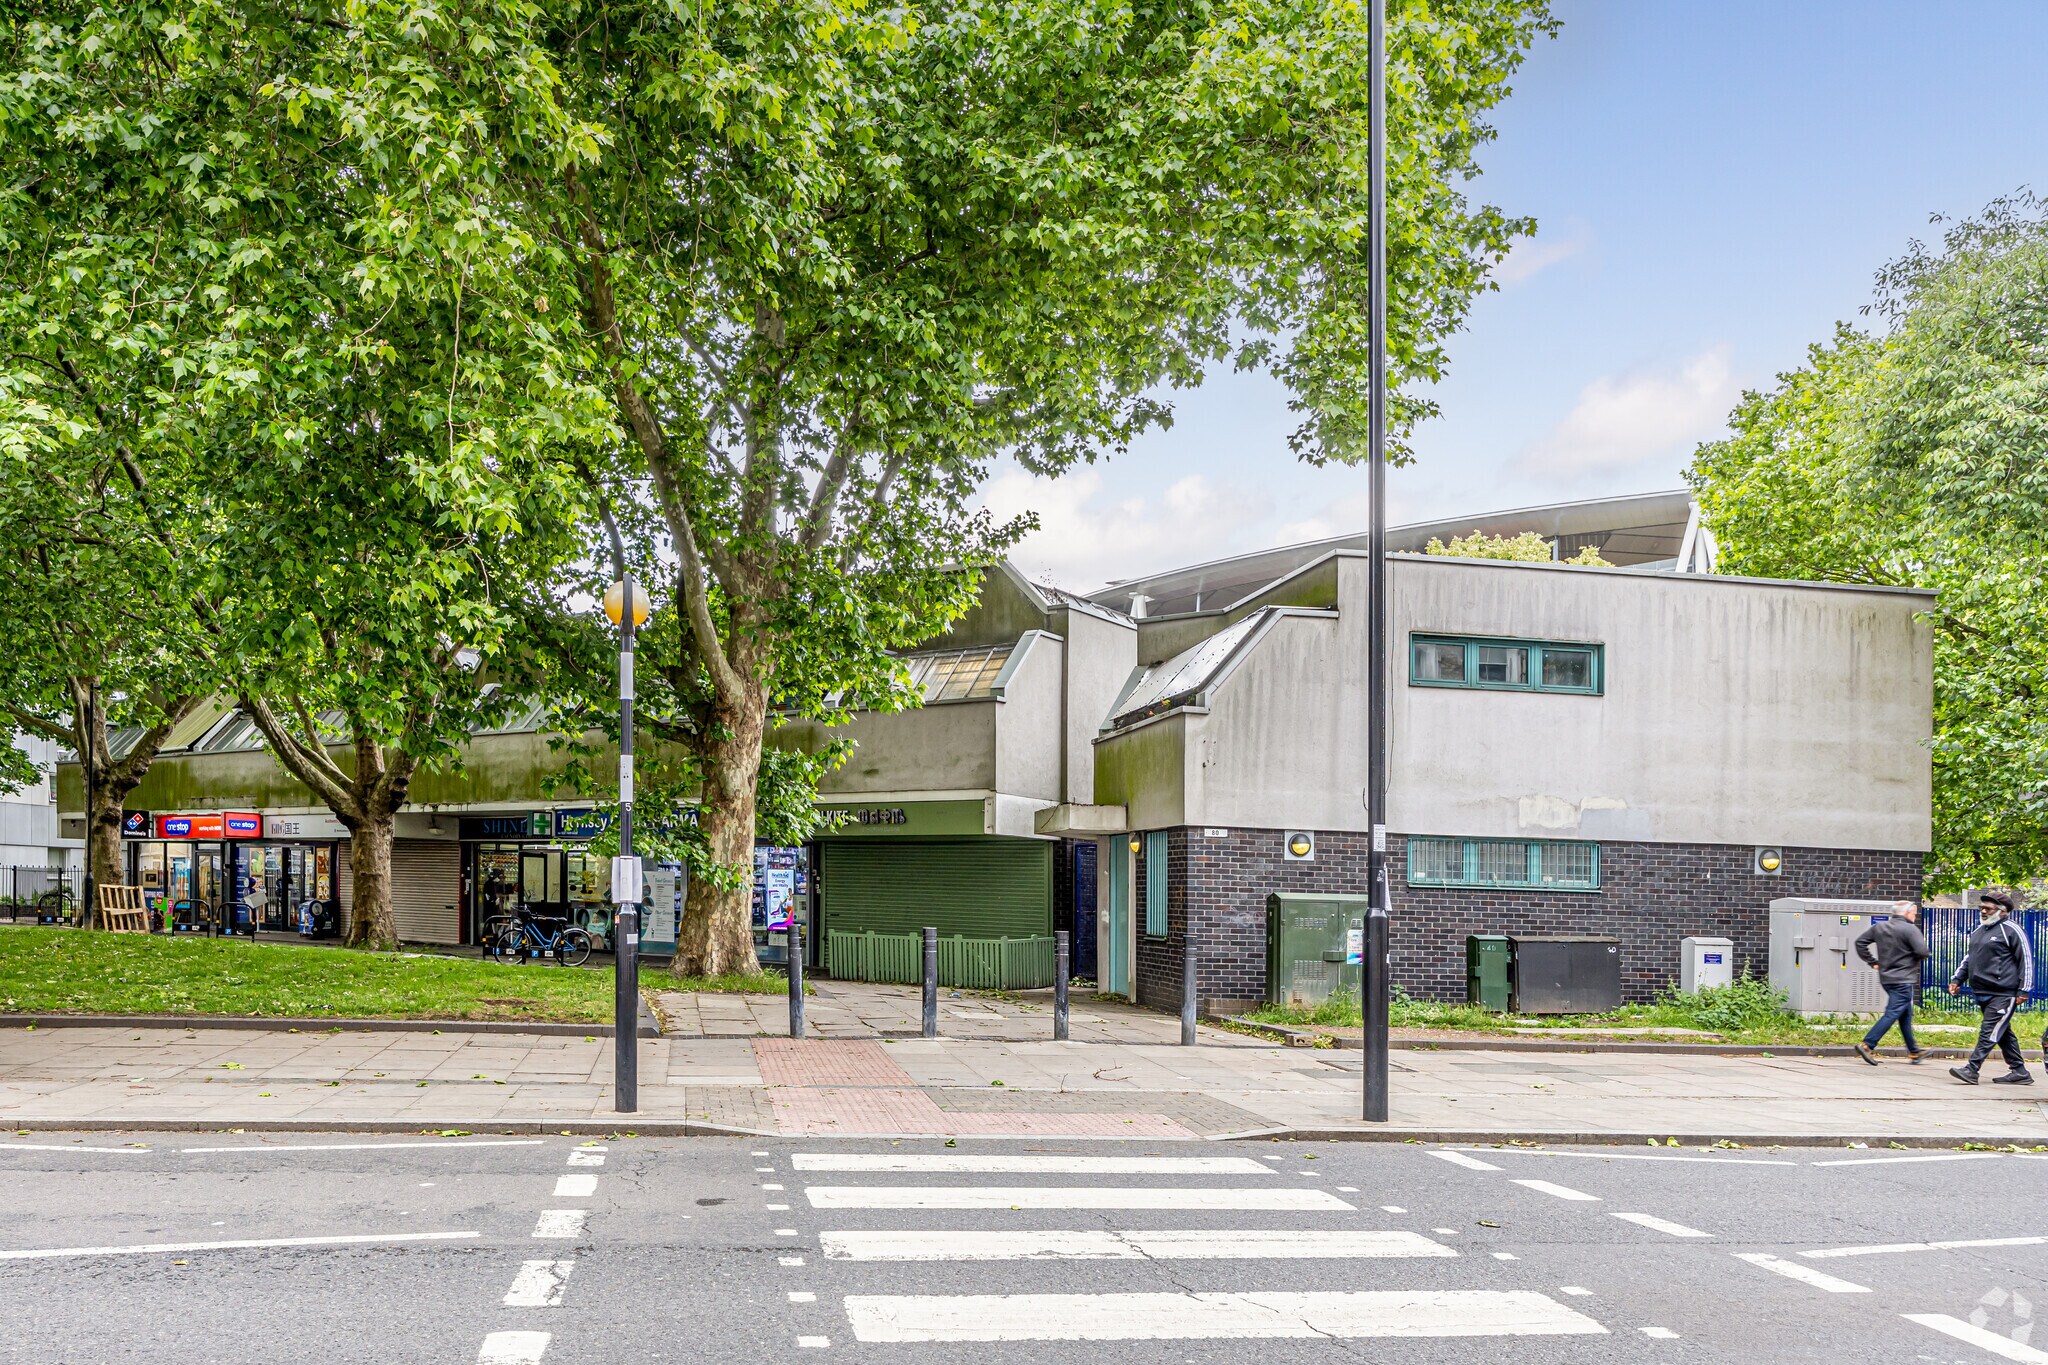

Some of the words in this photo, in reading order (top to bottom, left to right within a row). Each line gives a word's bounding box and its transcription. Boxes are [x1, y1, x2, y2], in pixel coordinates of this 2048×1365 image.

[625, 802, 632, 811] 5
[177, 822, 188, 833] stop
[241, 821, 255, 829] stop
